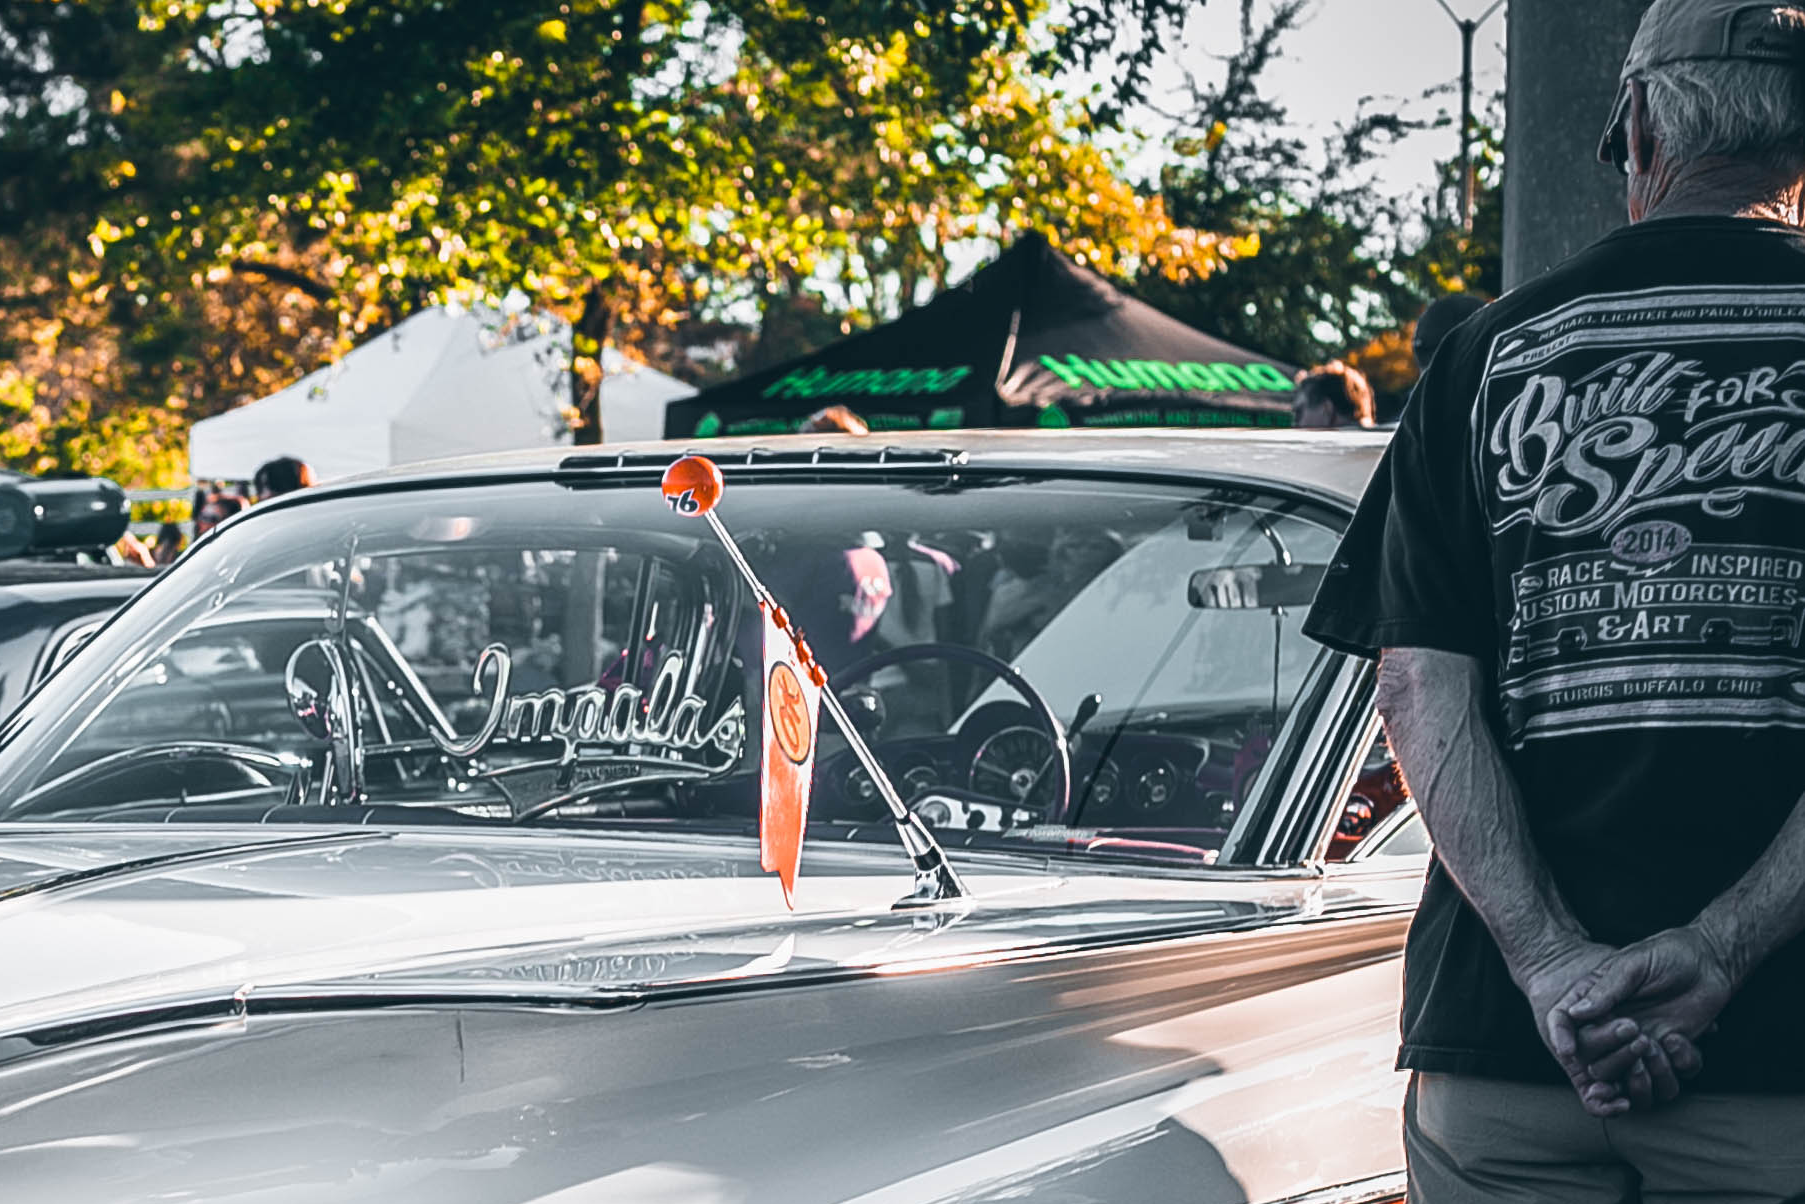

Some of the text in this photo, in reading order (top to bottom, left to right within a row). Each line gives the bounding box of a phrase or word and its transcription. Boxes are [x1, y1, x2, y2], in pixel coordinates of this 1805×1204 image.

[1538, 315, 1596, 342] MICHAEL
[1601, 310, 1667, 325] LICHTER
[1699, 307, 1738, 319] PAUL
[1039, 354, 1294, 392] Humana
[1490, 351, 1705, 501] Built
[666, 487, 700, 514] 76
[1623, 527, 1677, 552] 2014
[1547, 559, 1606, 587] RACE
[1691, 554, 1803, 579] INSPIRED
[1515, 581, 1799, 630] USTOM MOTORCYCLES
[1623, 679, 1705, 695] BUFFALO
[1717, 679, 1763, 695] CHIP
